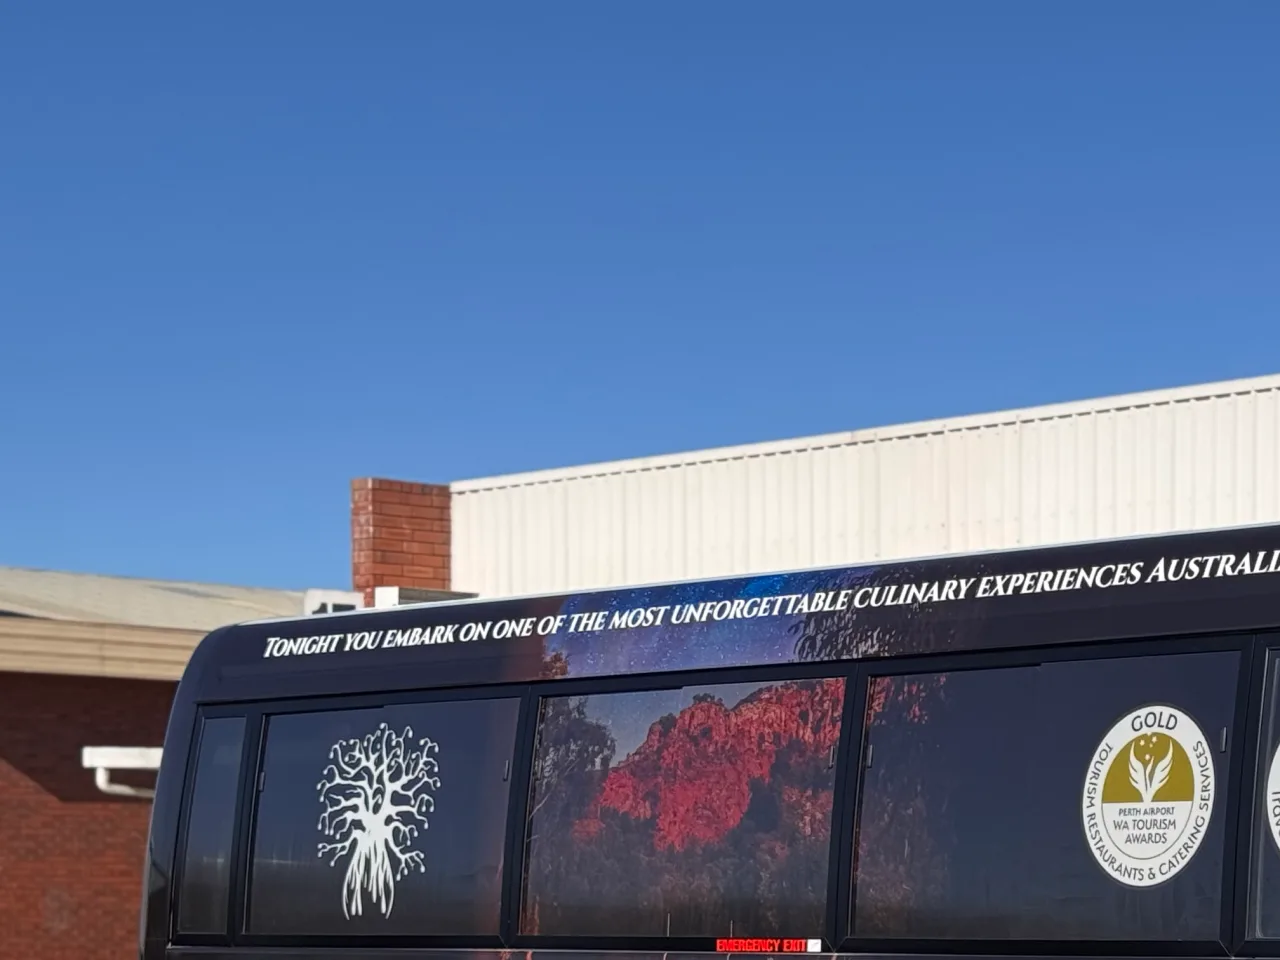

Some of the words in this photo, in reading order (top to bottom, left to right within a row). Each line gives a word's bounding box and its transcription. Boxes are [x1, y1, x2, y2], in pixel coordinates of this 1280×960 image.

[263, 632, 345, 659] TONIGHT
[343, 630, 384, 652] YOU
[381, 624, 460, 648] EMBARK
[459, 621, 492, 642] ON
[492, 617, 537, 639] ONE
[537, 614, 567, 636] OF
[568, 611, 609, 633] THE
[607, 605, 671, 630] MOST
[670, 589, 853, 625] UNFORGETTABLE
[853, 577, 976, 609] CULINARY
[976, 561, 1144, 598] EXPERIENCES
[1131, 711, 1178, 732] GOLD
[1086, 742, 1113, 808] TOURISM
[1193, 740, 1211, 811] SERVICES
[1118, 808, 1141, 817] PERTH
[1143, 806, 1175, 816] AIRPORT
[1113, 819, 1130, 831] WA
[1132, 818, 1176, 830] TOURISM
[1087, 812, 1144, 881] RESTAURANTS
[1124, 833, 1168, 844] AWARDS
[1159, 815, 1205, 876] CATERING
[1148, 867, 1156, 880] &
[716, 939, 780, 952] EMERGENCY
[783, 939, 806, 952] EXIT
